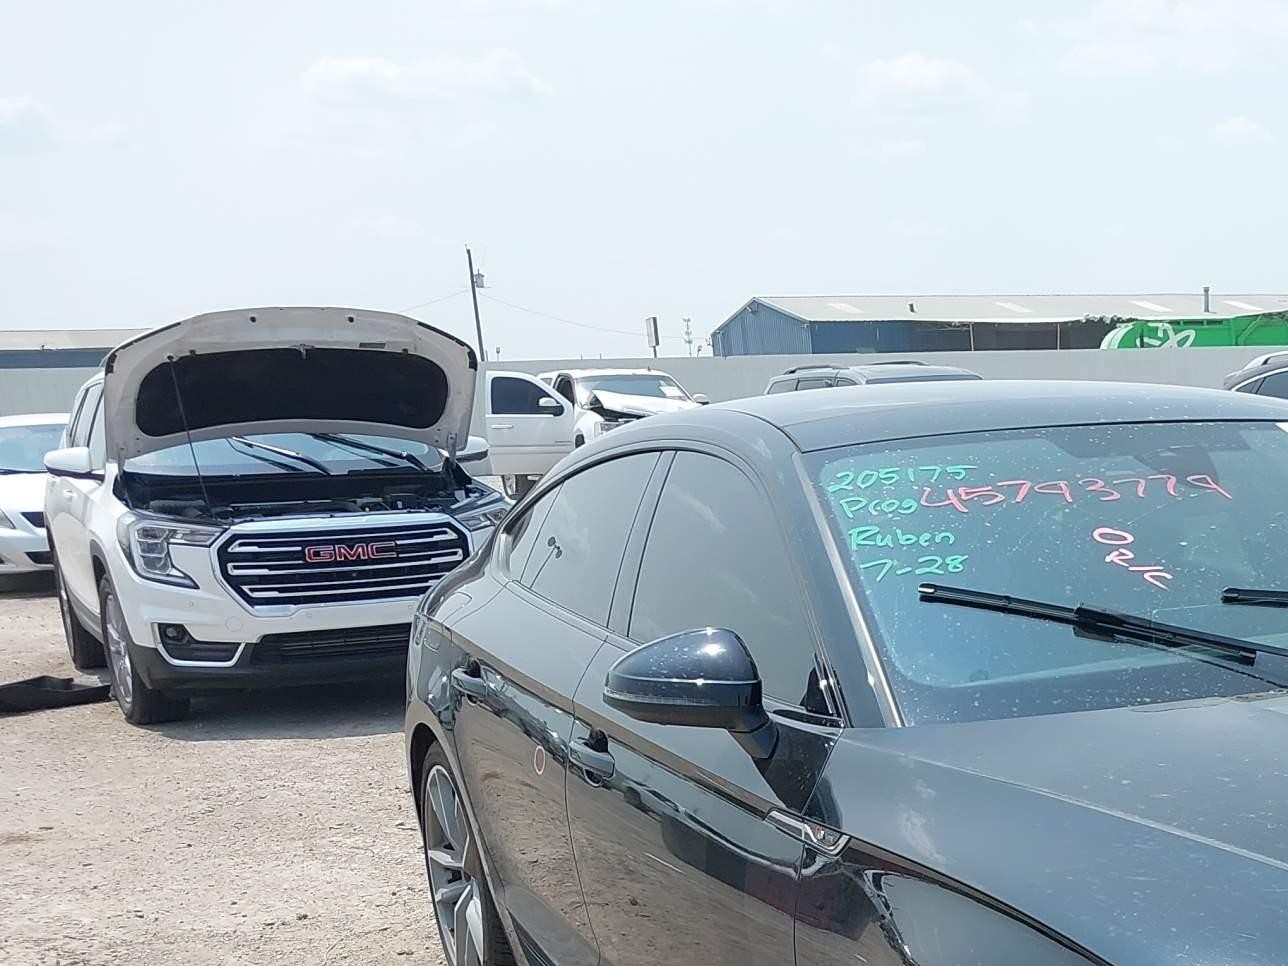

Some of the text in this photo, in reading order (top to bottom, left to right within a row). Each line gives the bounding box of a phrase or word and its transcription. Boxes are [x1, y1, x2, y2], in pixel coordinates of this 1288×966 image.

[827, 464, 978, 493] 205175
[920, 474, 1232, 513] 45793779
[848, 525, 955, 550] Ruben
[305, 541, 397, 563] GMC
[859, 555, 969, 582] 7-28
